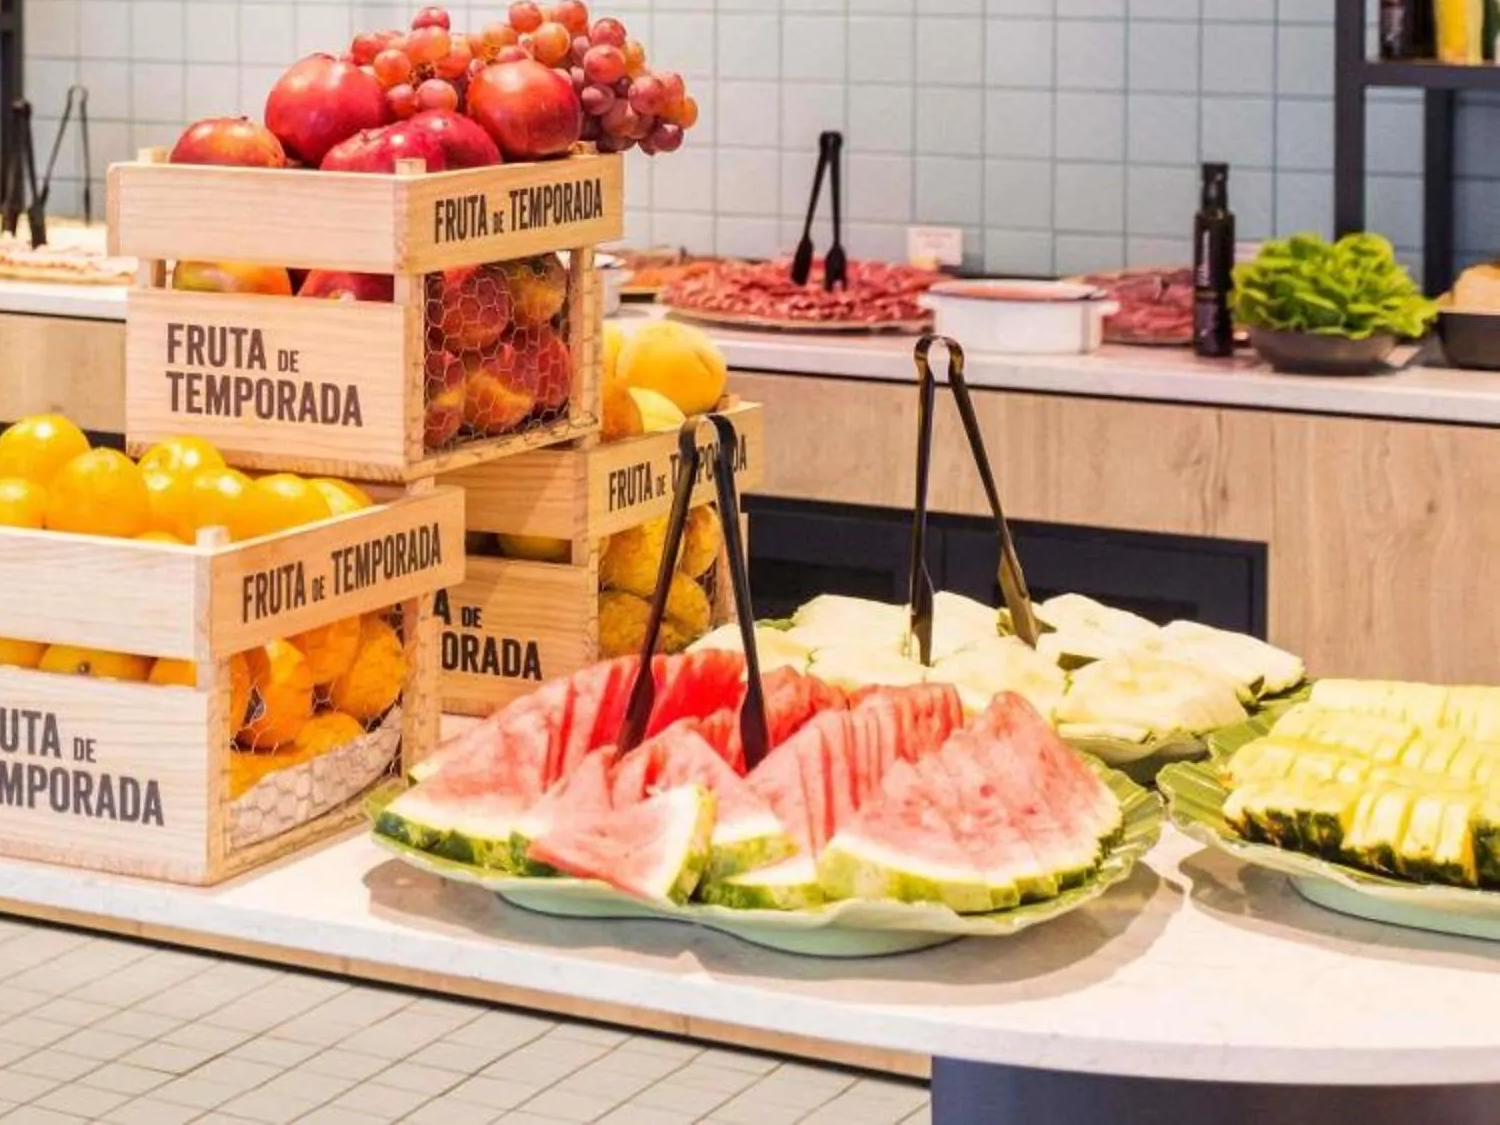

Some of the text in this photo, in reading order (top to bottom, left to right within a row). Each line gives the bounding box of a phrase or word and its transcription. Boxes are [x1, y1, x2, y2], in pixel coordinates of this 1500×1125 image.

[435, 178, 603, 244] FRUTA DE TEMPORADA
[167, 323, 300, 374] FRUTA DE
[165, 371, 363, 427] TEMPORADA
[609, 461, 653, 512] FRUTA
[243, 522, 442, 624] FRUTA DE TEMPORADA
[461, 606, 483, 629] DE
[441, 630, 543, 681] ORADA
[73, 737, 97, 763] DE
